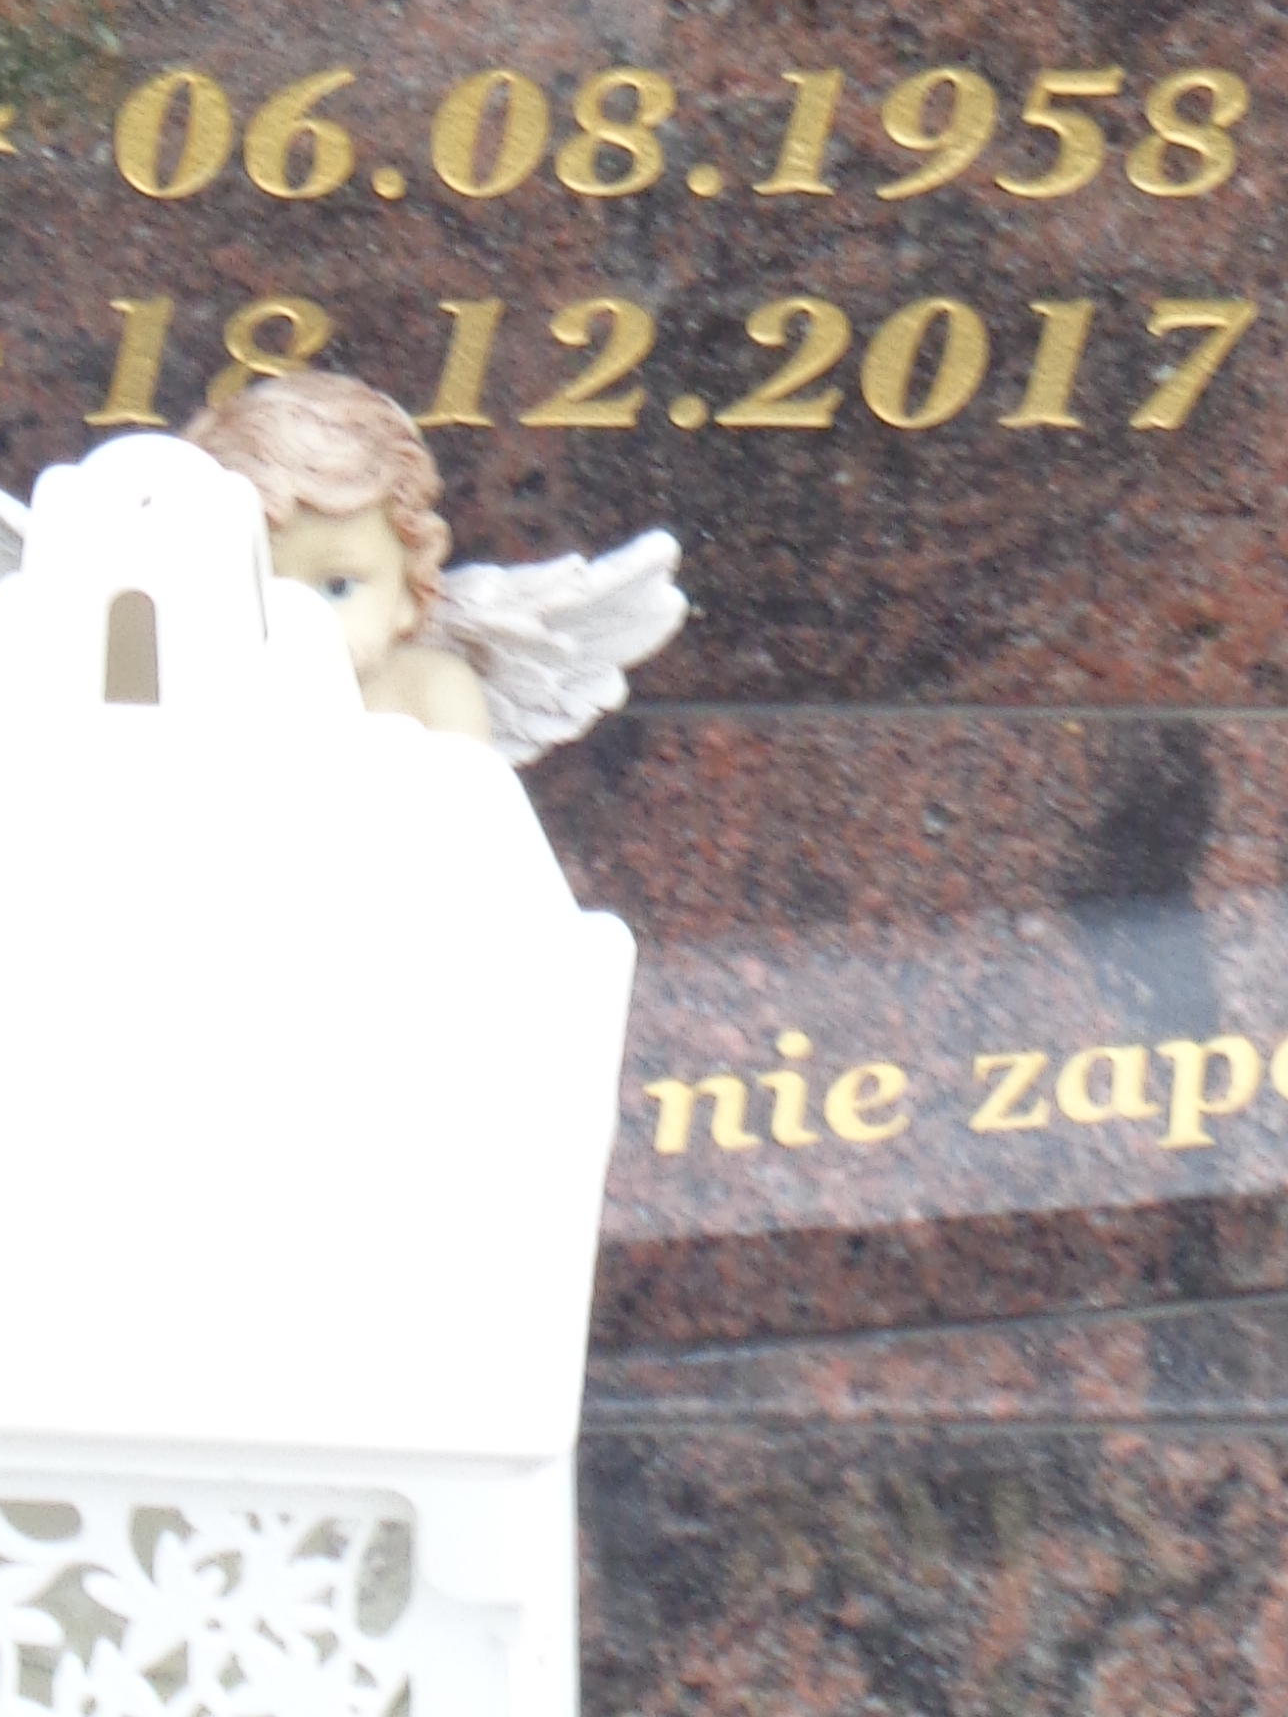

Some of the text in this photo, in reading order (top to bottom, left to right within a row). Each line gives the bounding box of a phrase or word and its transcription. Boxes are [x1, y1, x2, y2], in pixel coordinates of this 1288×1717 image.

[114, 67, 1250, 200] 06.08.1958
[84, 296, 1258, 430] 1812.2017
[644, 1032, 907, 1154] nie
